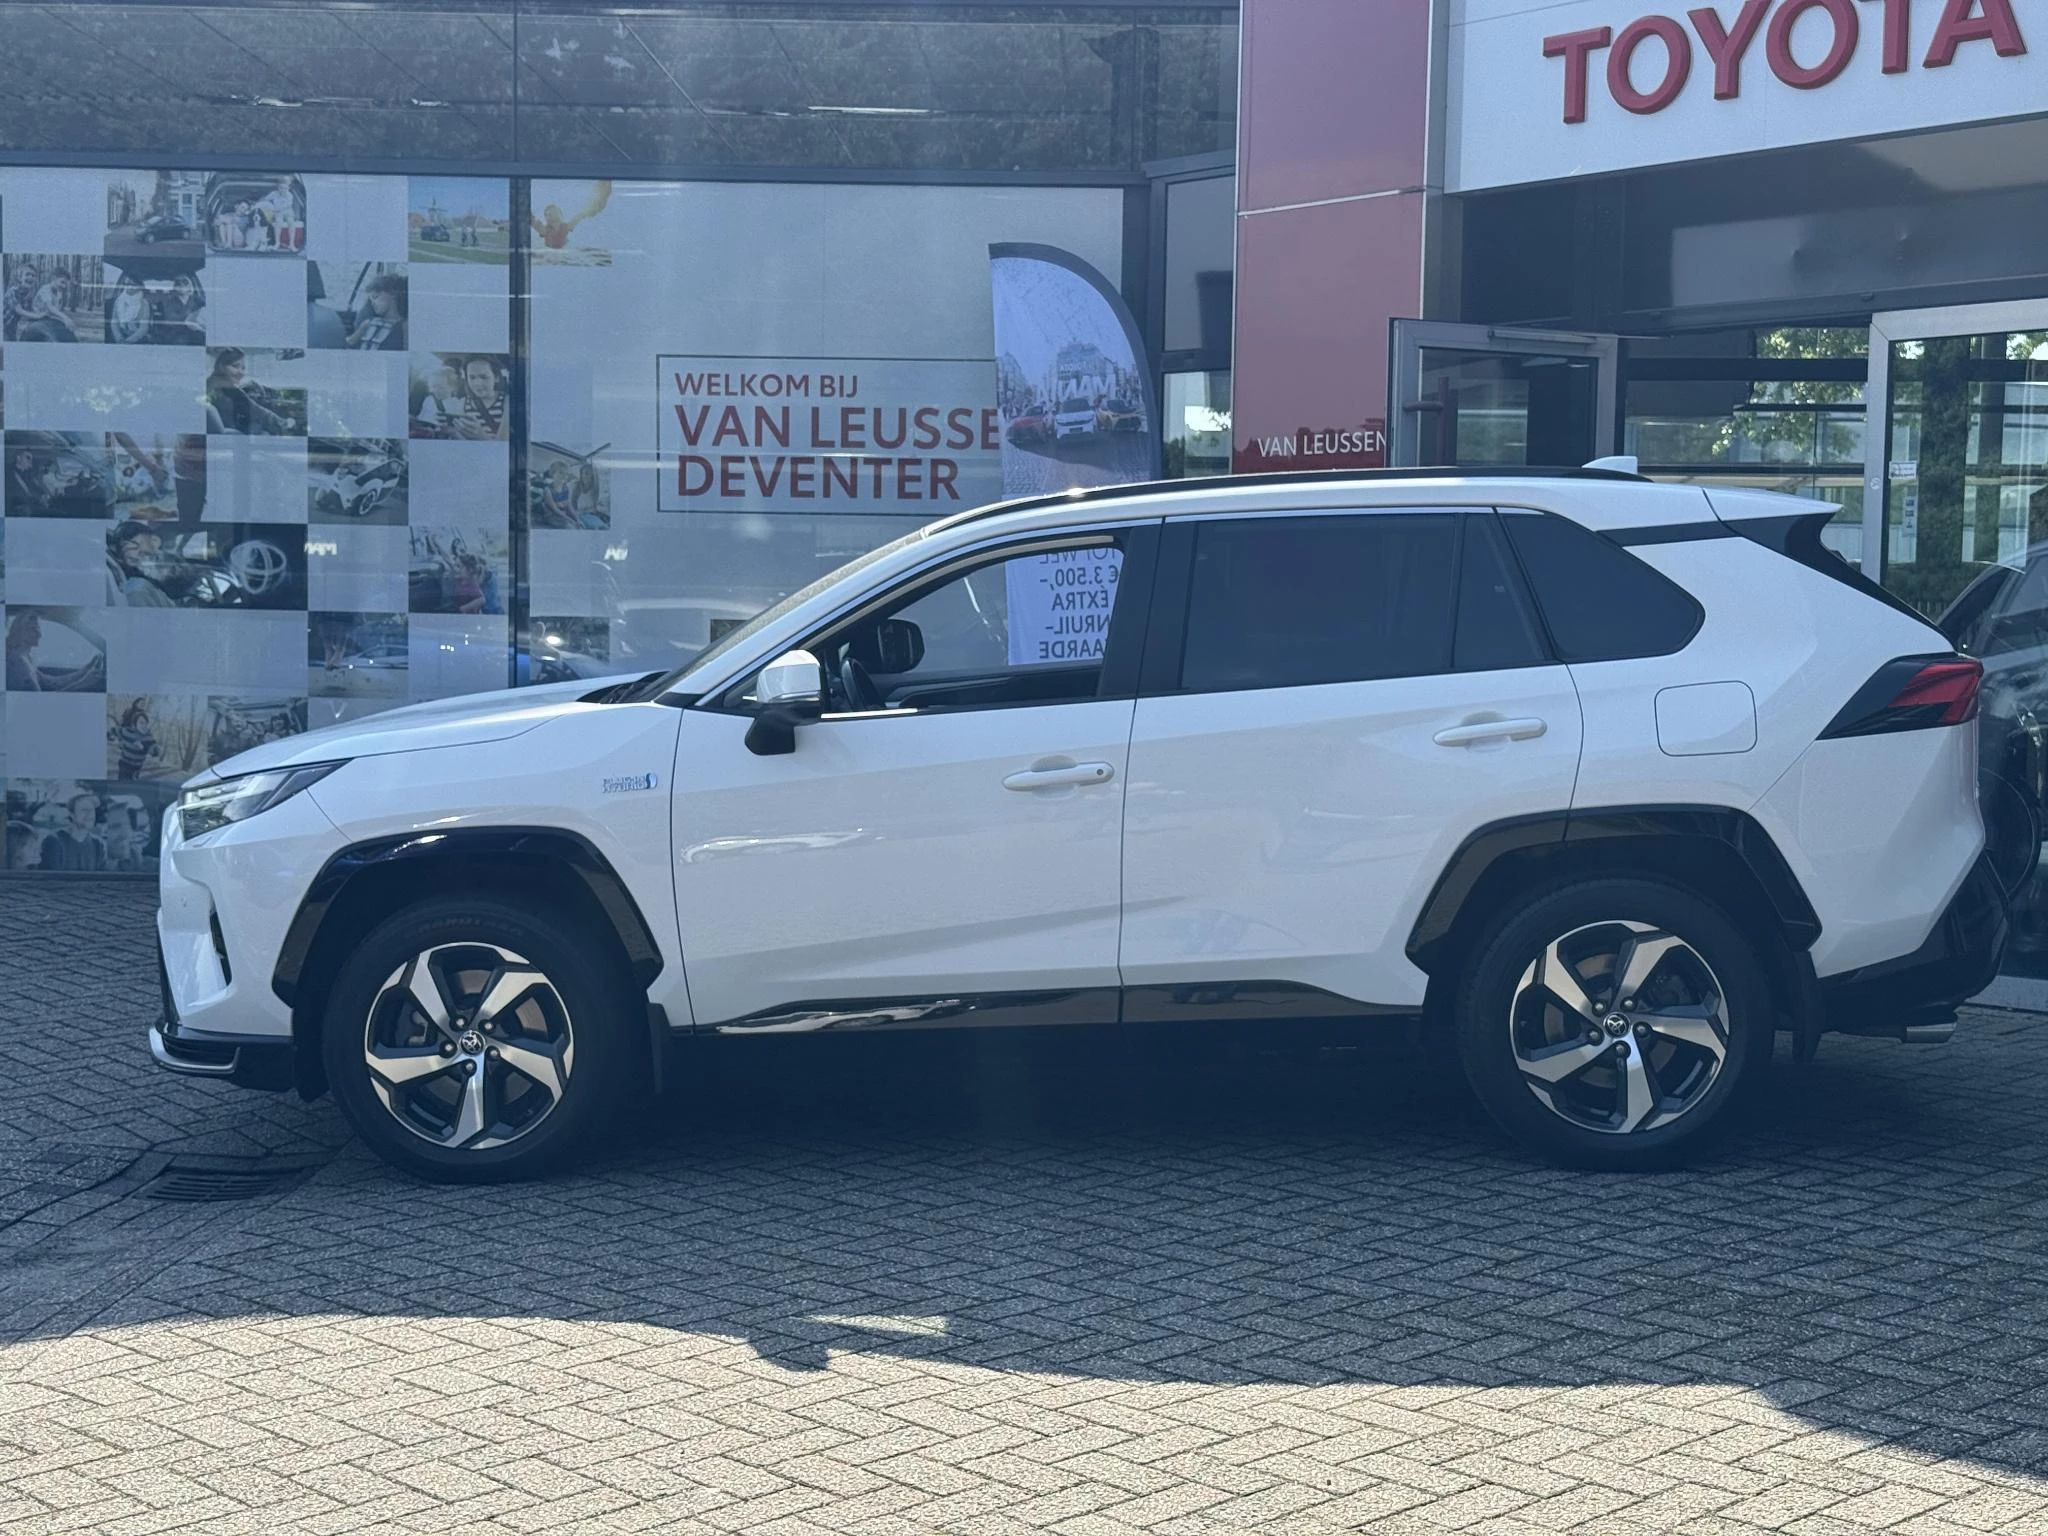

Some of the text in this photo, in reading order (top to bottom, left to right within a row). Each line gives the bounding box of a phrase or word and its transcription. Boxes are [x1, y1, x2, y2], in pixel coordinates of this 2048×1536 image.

[1543, 0, 2027, 125] TOYOTA
[674, 372, 858, 398] WELKOM BIJ
[674, 404, 1000, 450] VAN LEUSSE
[1257, 431, 1386, 457] VAN LEUSSEN
[678, 454, 961, 500] DEVENTER
